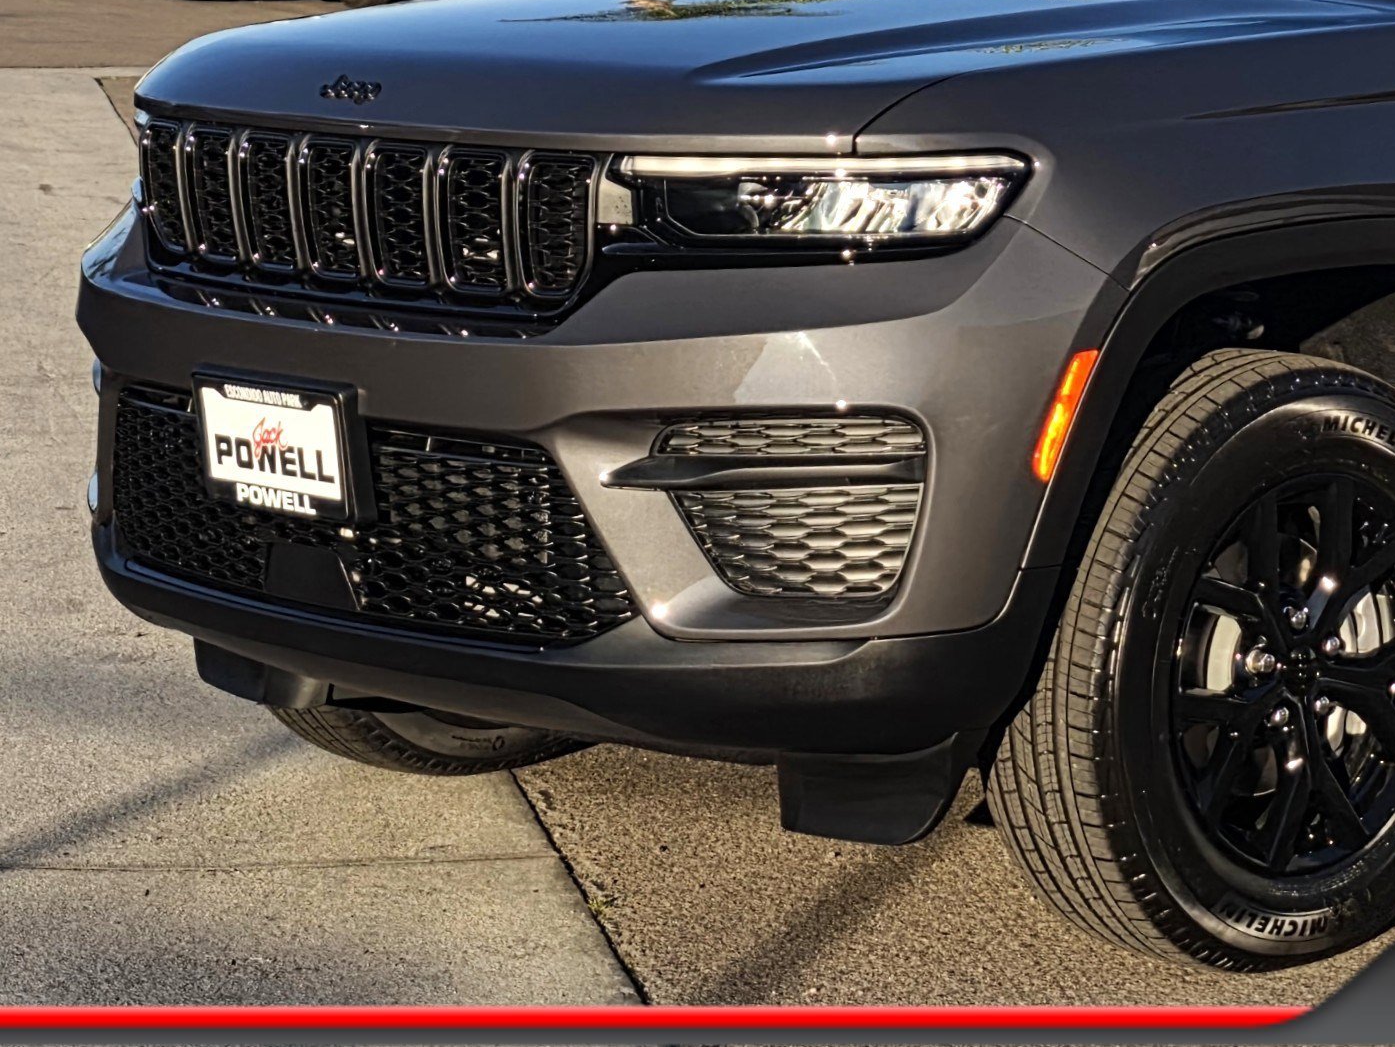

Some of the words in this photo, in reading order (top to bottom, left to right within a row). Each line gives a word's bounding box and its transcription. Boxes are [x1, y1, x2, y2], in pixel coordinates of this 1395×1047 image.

[319, 74, 382, 106] Jeep
[281, 393, 302, 408] PARK
[252, 417, 288, 459] Jack
[214, 433, 335, 484] POWELL
[235, 482, 317, 516] POWELL
[1219, 905, 1328, 937] MICHELIN
